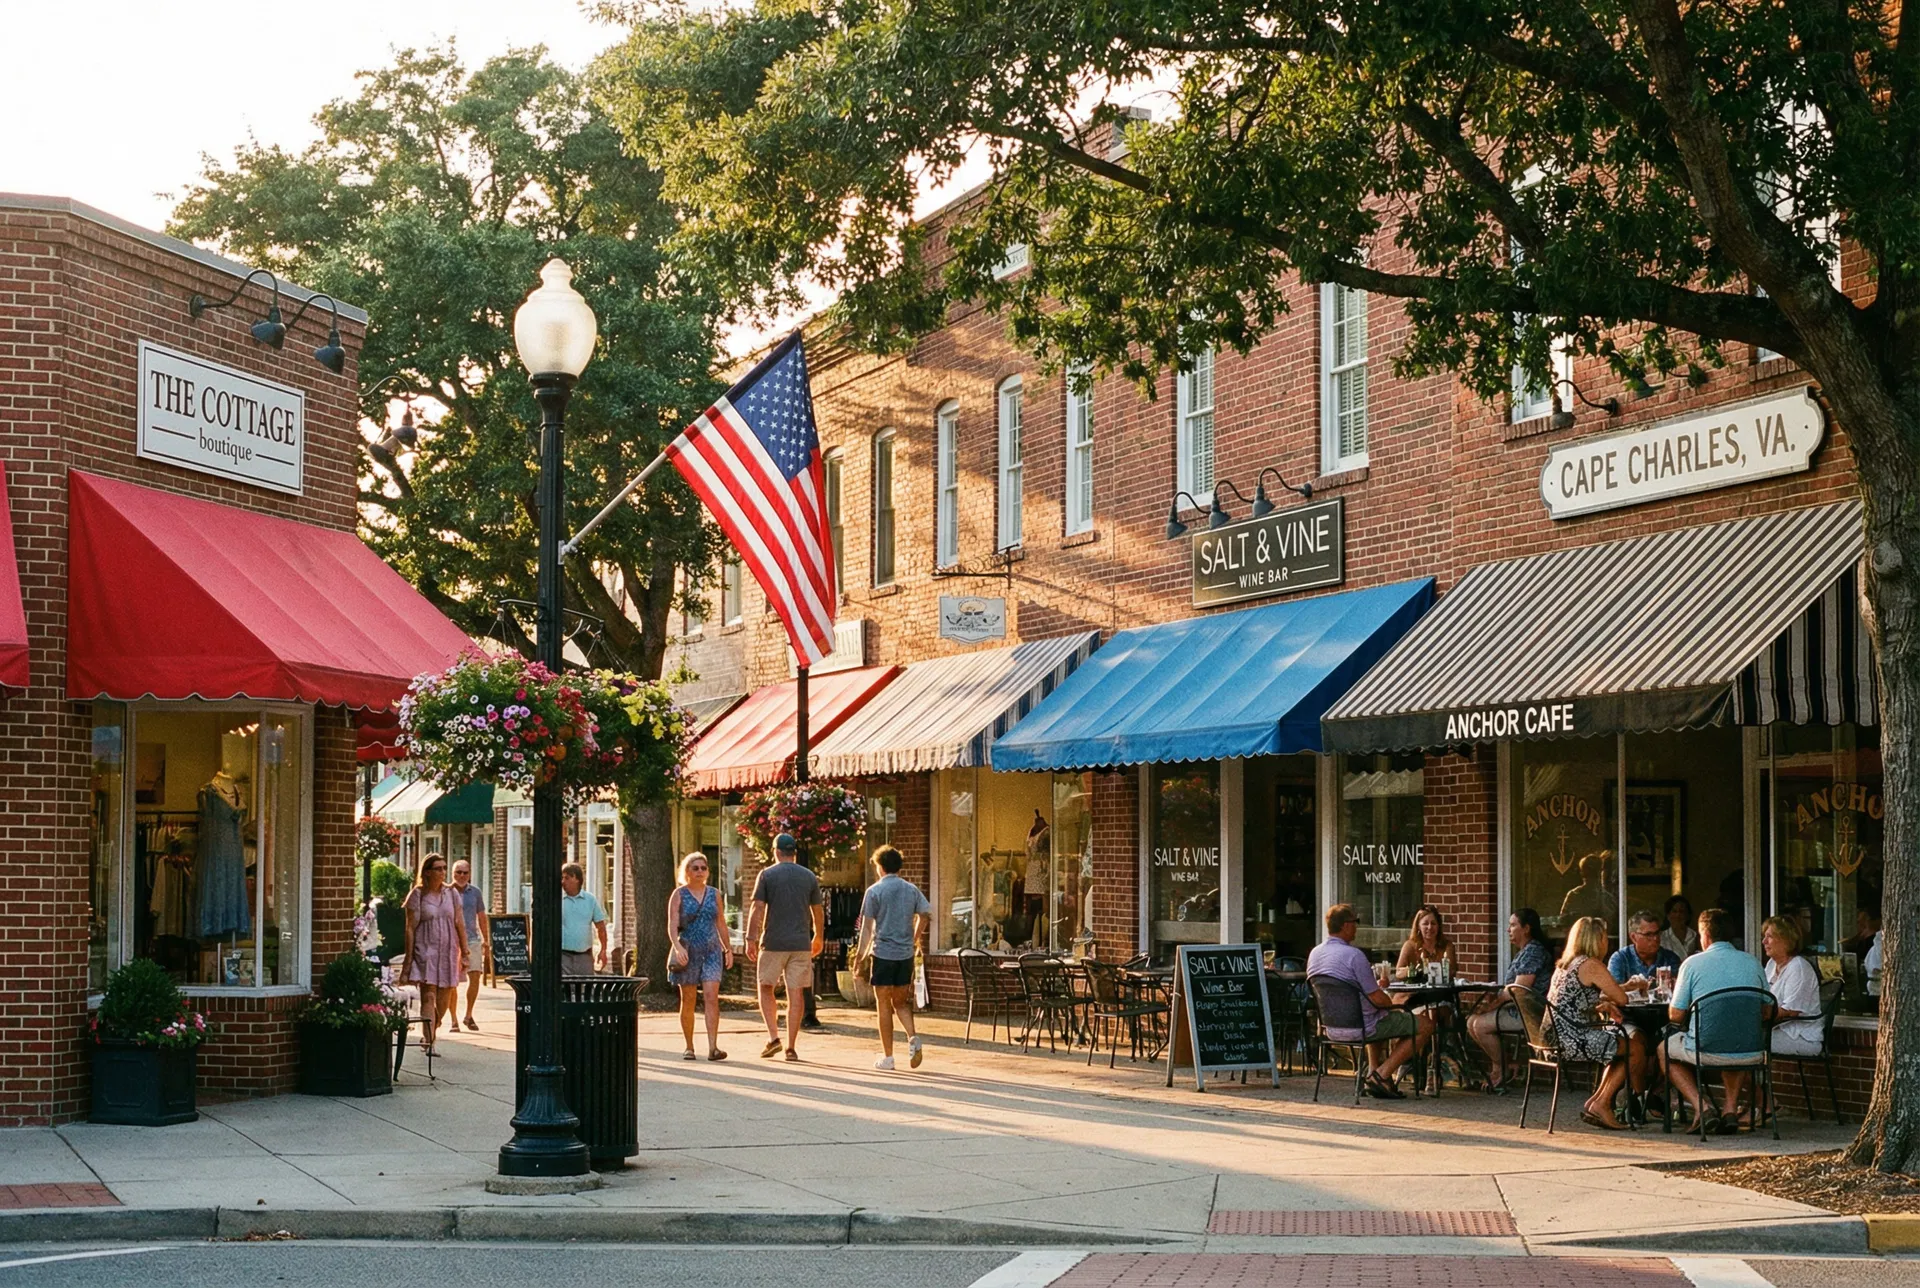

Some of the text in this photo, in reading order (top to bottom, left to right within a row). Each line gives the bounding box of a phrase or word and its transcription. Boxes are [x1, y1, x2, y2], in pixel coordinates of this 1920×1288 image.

[151, 369, 295, 446] THE COTTAGE
[199, 427, 252, 465] boutique
[1560, 413, 1796, 498] CAPE CHARLES, VA.
[1200, 514, 1330, 575] SALT & VINE
[1239, 566, 1288, 589] WINE BAR
[1445, 703, 1574, 740] ANCHOR CAFE
[1525, 794, 1601, 840] ANCHOR
[1795, 783, 1884, 832] ANCHO
[1154, 847, 1219, 867] SALT & VINE
[1342, 843, 1424, 866] SALT & VINE
[1385, 872, 1401, 883] BAR
[1189, 956, 1218, 975] SALT
[1226, 955, 1255, 974] VINE
[1200, 980, 1244, 994] Wine Bar
